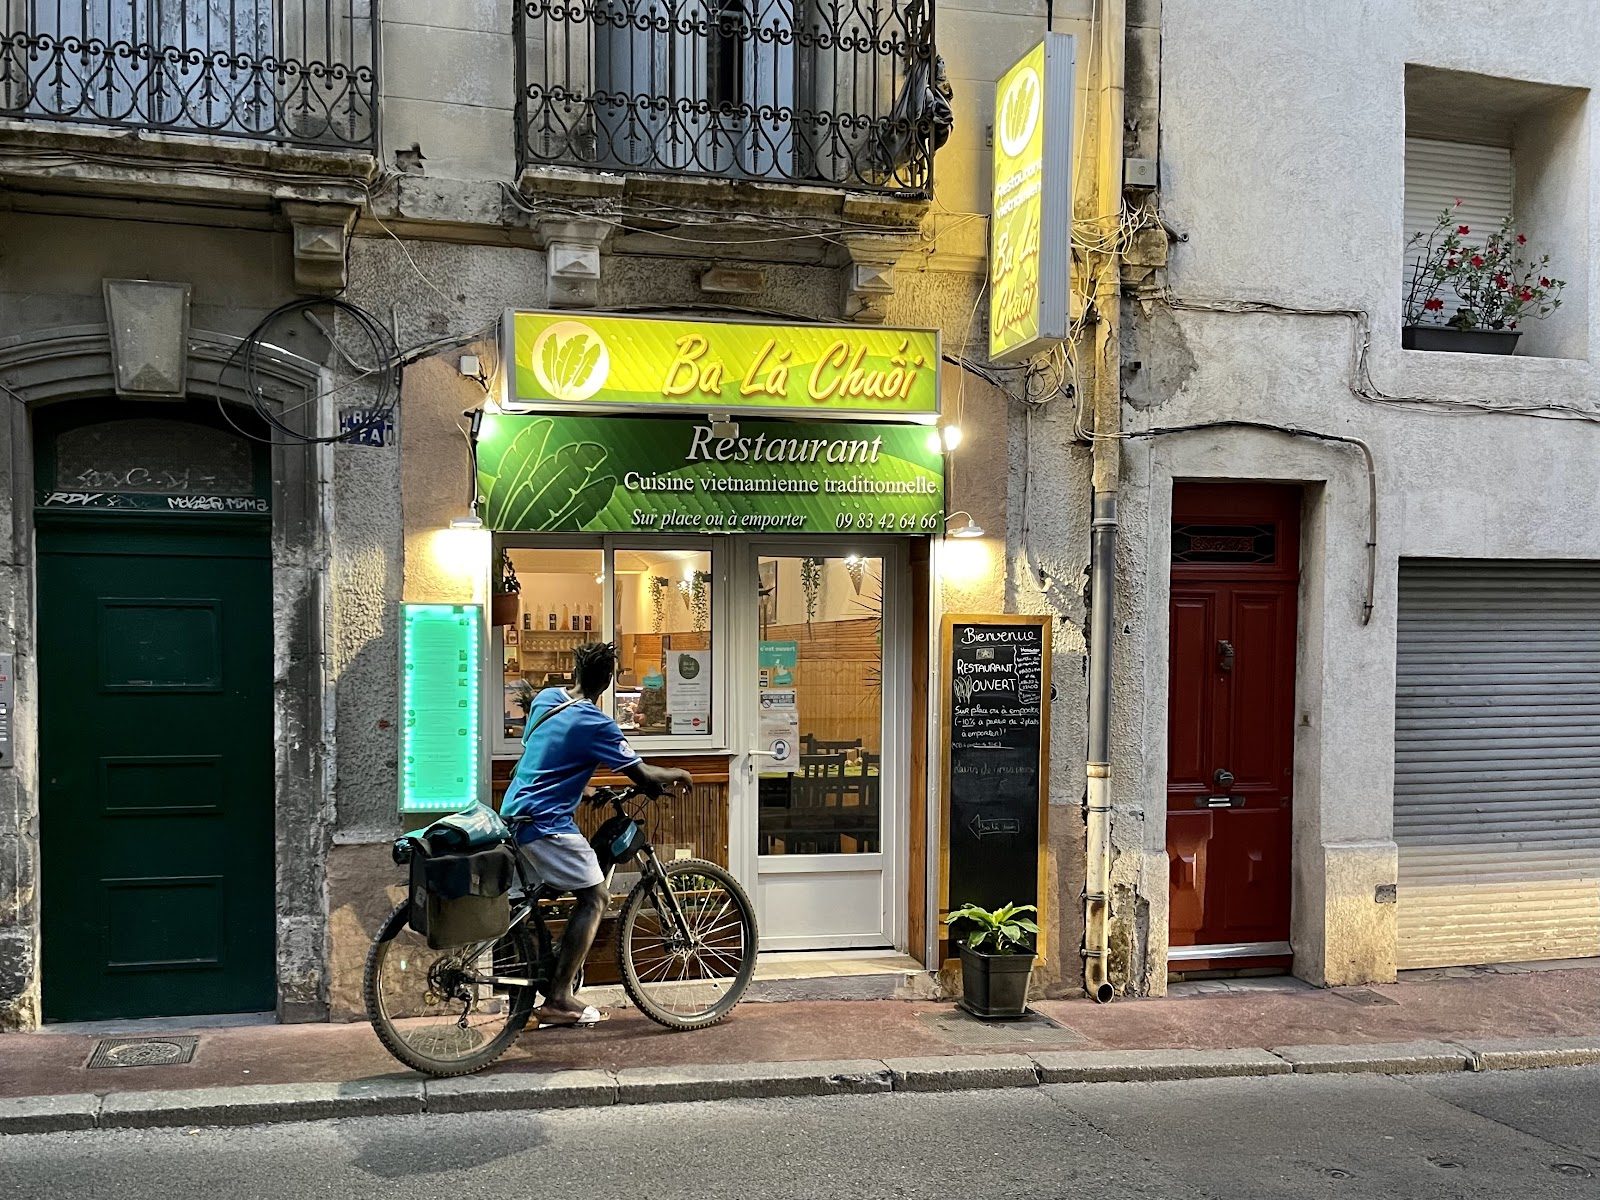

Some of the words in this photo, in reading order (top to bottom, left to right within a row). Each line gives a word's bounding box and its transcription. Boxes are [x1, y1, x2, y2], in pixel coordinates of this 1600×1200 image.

[662, 334, 723, 396] Ba
[740, 339, 791, 396] Lá
[808, 338, 924, 400] Chuối
[685, 425, 883, 464] Restaurant
[624, 472, 694, 491] Cuisine
[700, 473, 819, 492] vietnamienne
[824, 475, 937, 494] traditionnelle
[631, 509, 658, 525] Sur
[660, 509, 701, 529] place
[705, 514, 724, 526] ou
[728, 510, 738, 526] à
[741, 512, 807, 531] emporter
[836, 512, 853, 529] 09
[857, 512, 874, 529] 83
[878, 512, 895, 529] 42
[899, 512, 916, 529] 64
[920, 512, 937, 529] 66
[961, 627, 1038, 644] Bienvenue
[972, 678, 1017, 692] OUVERT
